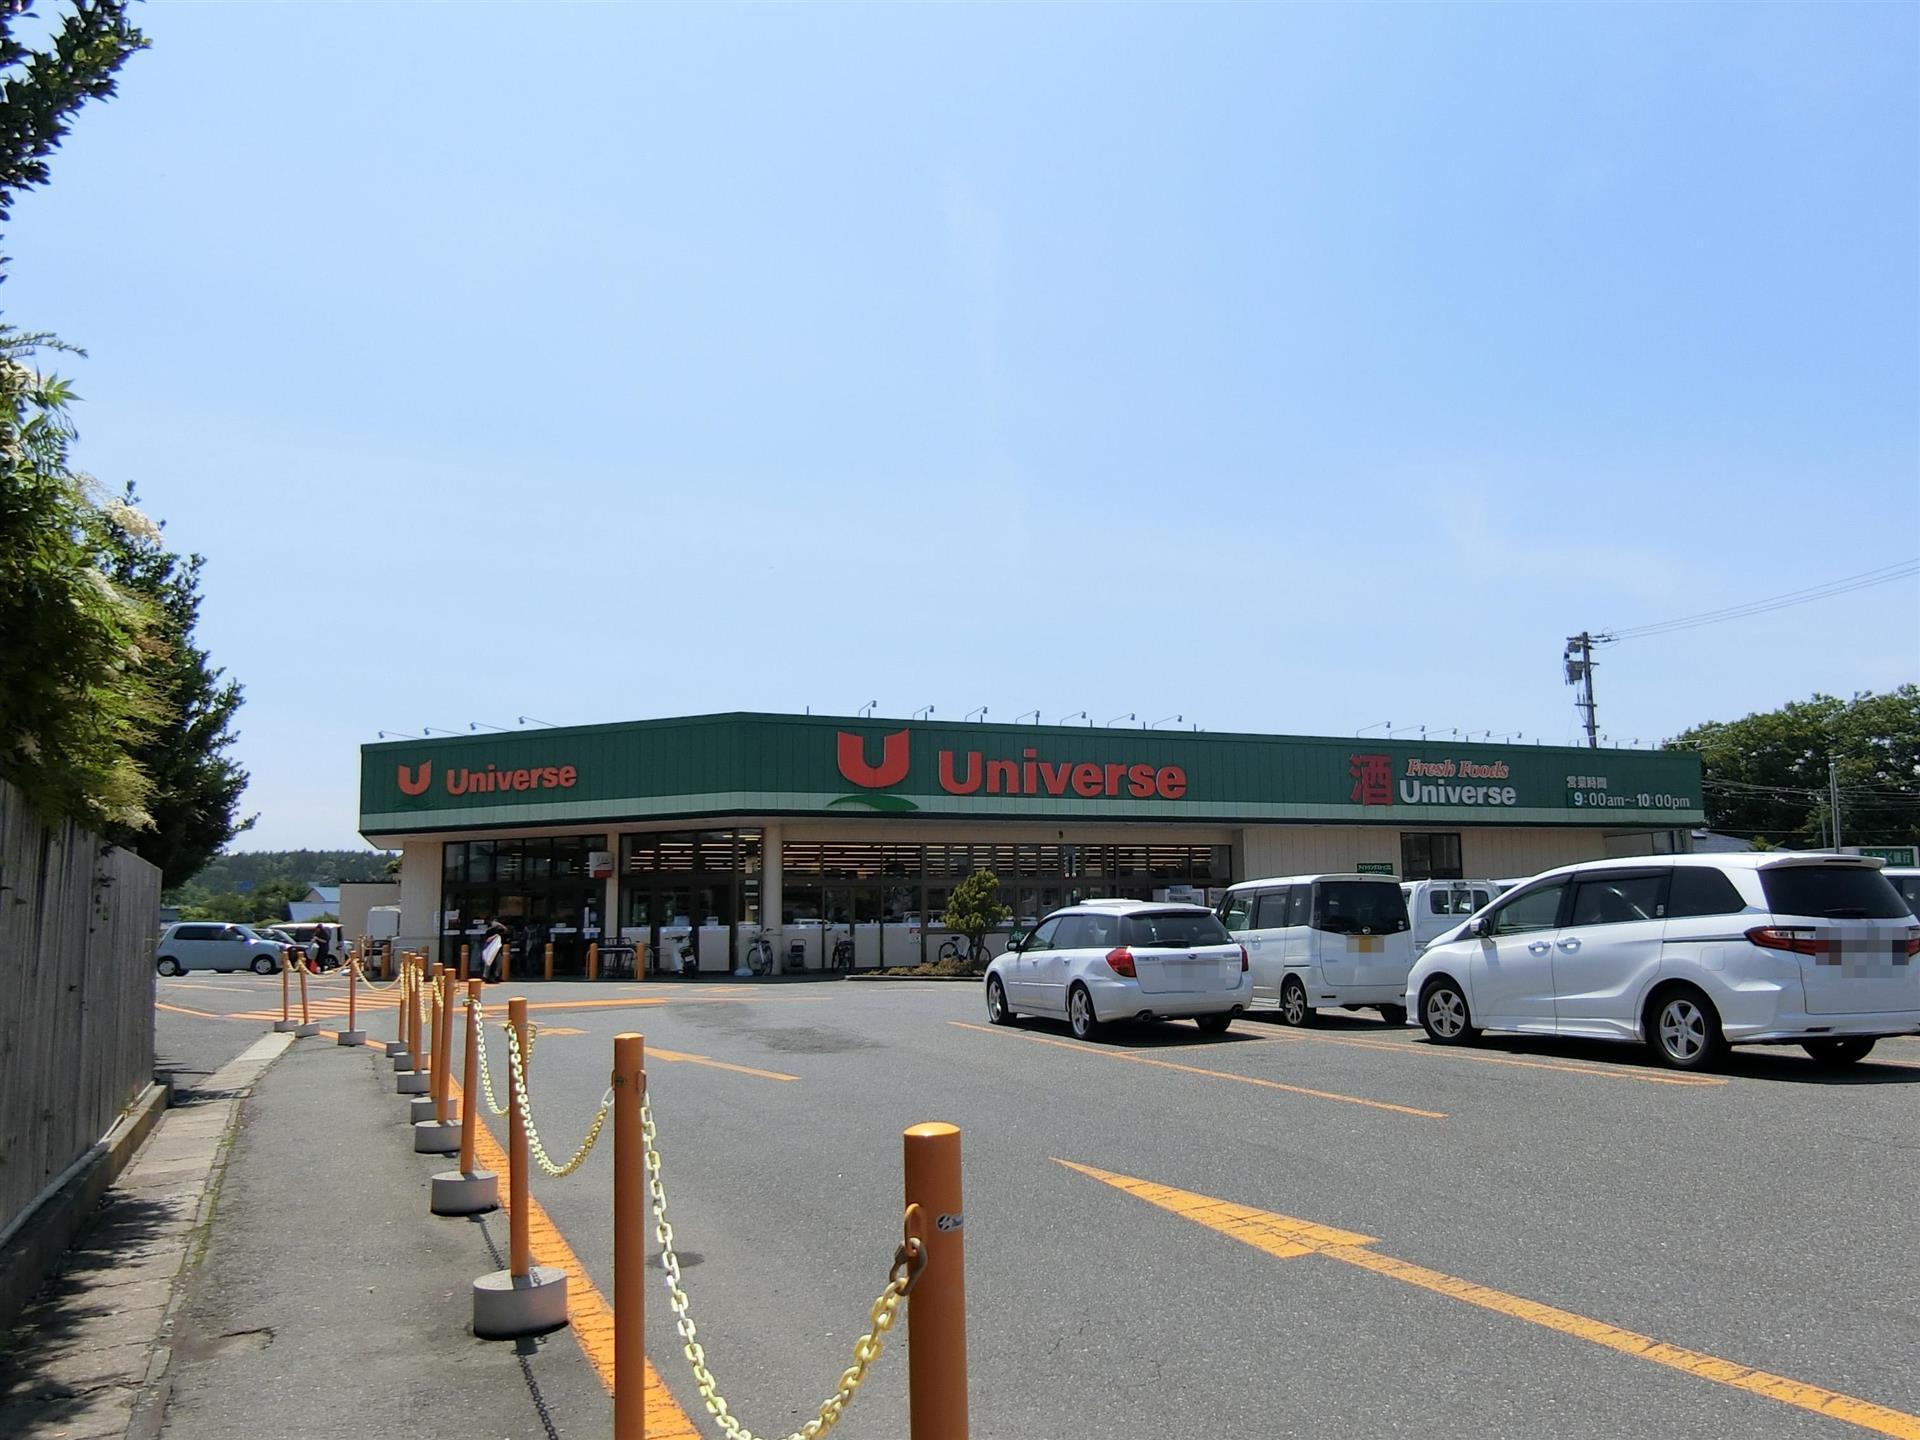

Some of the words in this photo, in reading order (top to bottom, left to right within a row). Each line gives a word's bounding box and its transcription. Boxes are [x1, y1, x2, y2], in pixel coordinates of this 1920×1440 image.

[447, 764, 577, 795] Universe
[938, 748, 1187, 799] Universe
[1349, 754, 1393, 806] 酒
[1406, 759, 1456, 777] Fresh
[1458, 760, 1510, 778] Foods
[1400, 779, 1517, 805] Universe
